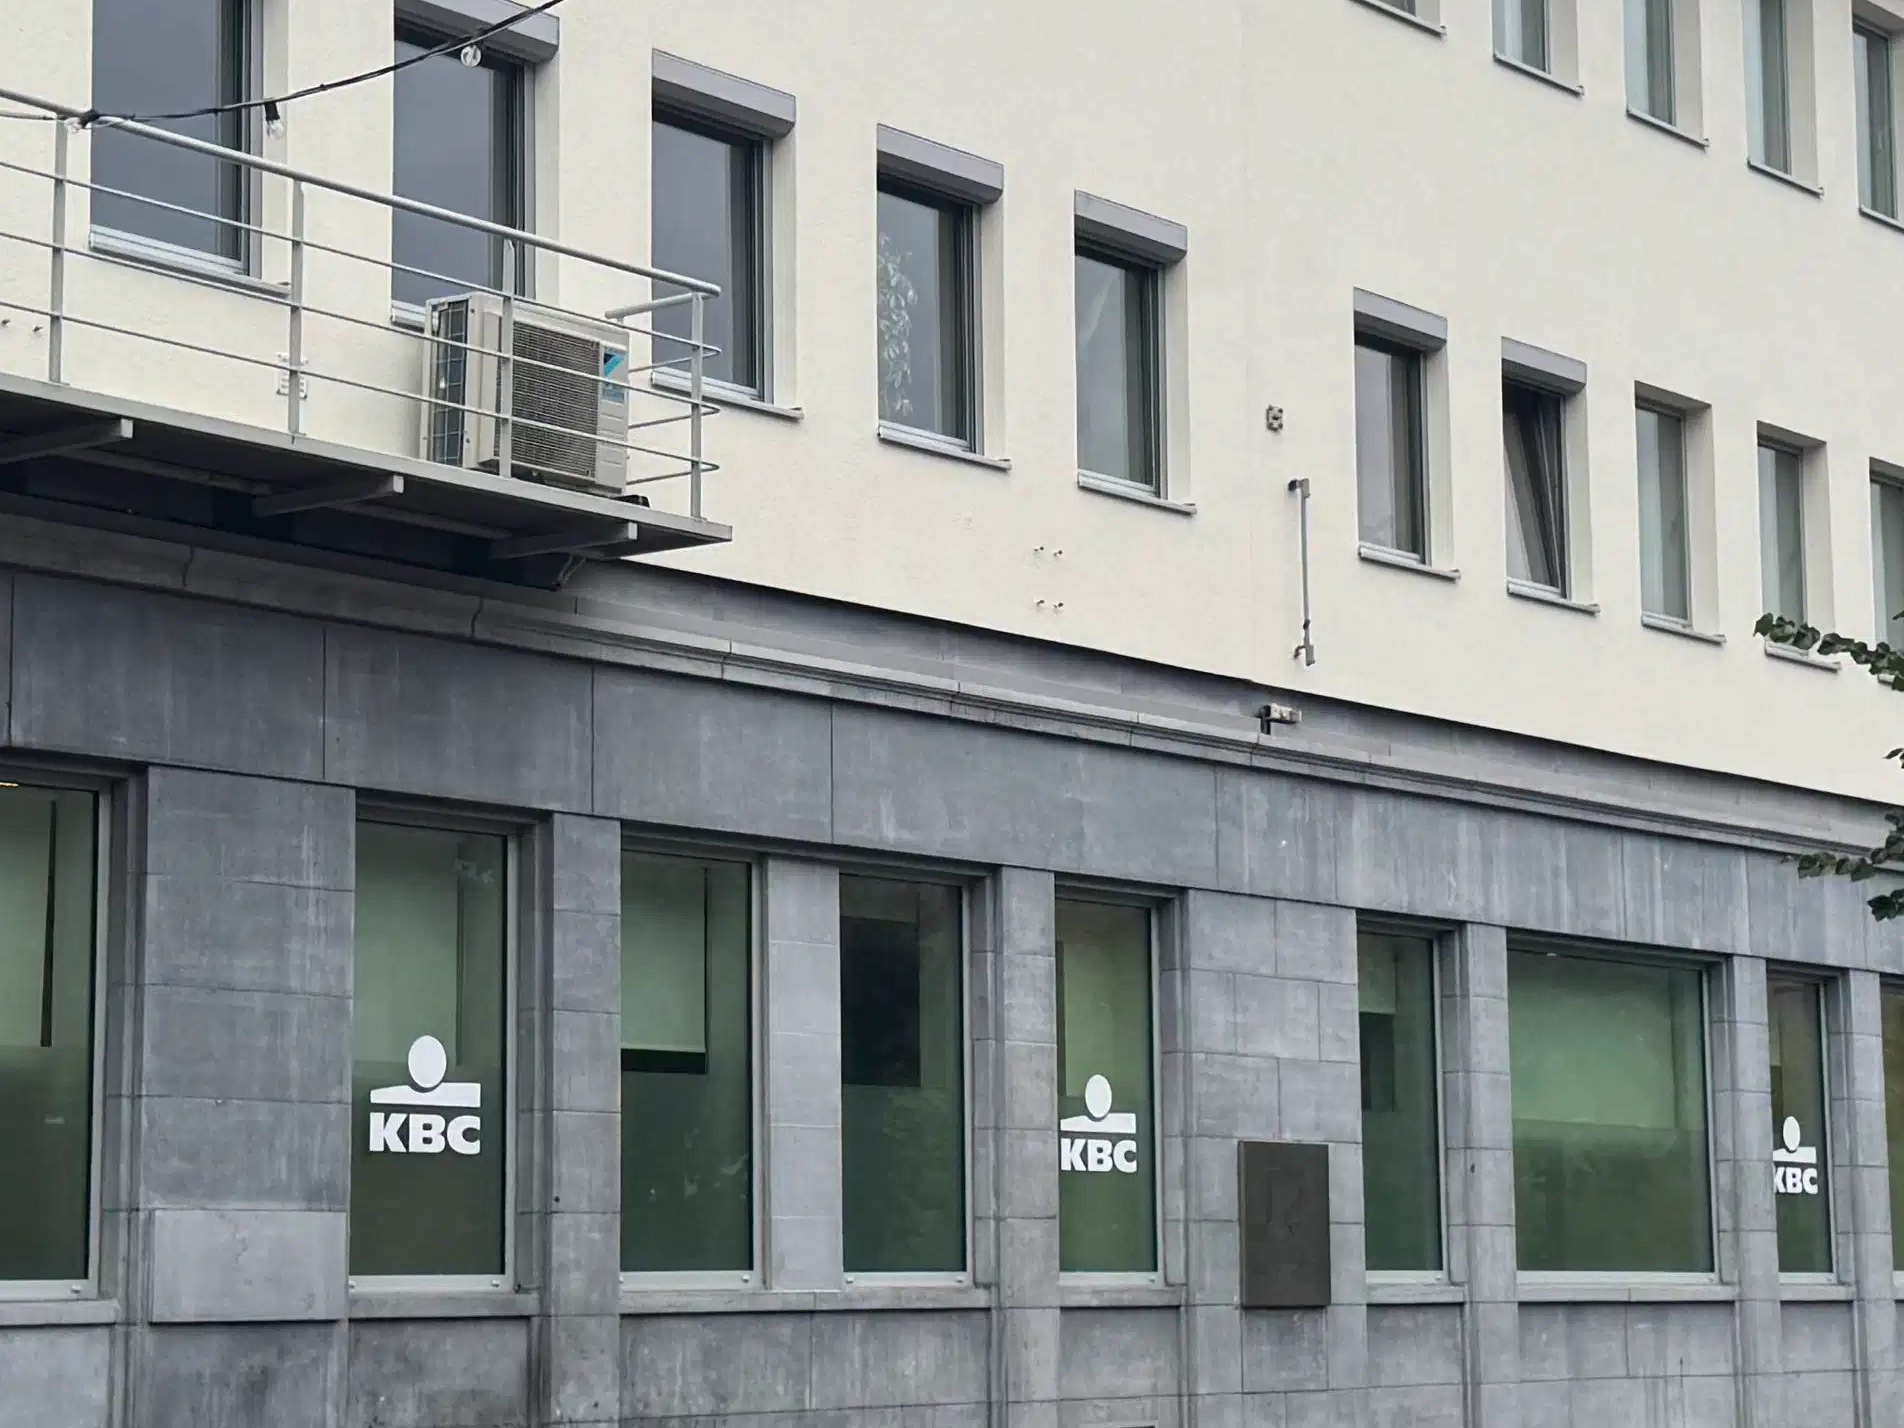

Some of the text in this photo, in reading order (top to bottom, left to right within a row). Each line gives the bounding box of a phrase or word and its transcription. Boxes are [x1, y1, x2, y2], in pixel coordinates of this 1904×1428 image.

[369, 1111, 481, 1156] KBC
[1061, 1137, 1138, 1174] KBC
[1772, 1166, 1818, 1195] KBC
